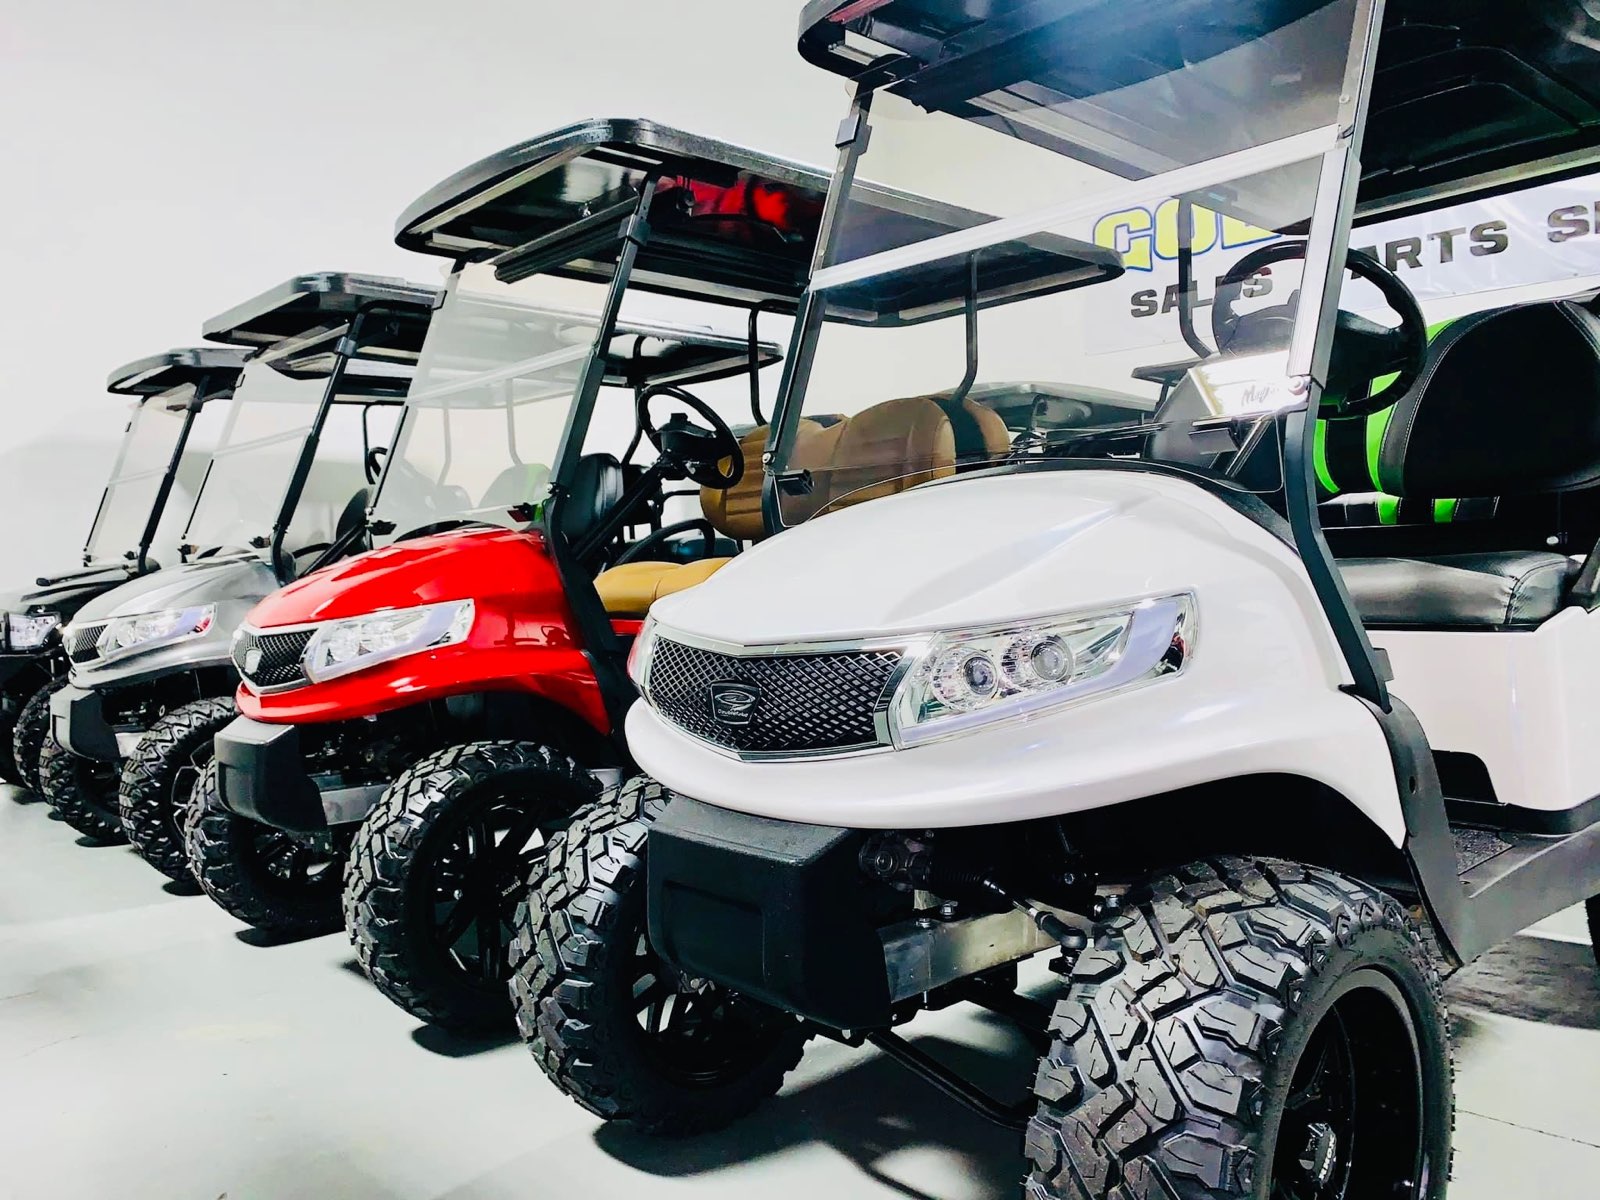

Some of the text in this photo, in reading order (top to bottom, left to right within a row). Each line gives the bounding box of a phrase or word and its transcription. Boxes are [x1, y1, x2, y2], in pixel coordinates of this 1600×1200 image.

[1093, 197, 1282, 272] GOL
[1130, 201, 1600, 318] SALS ARTS S
